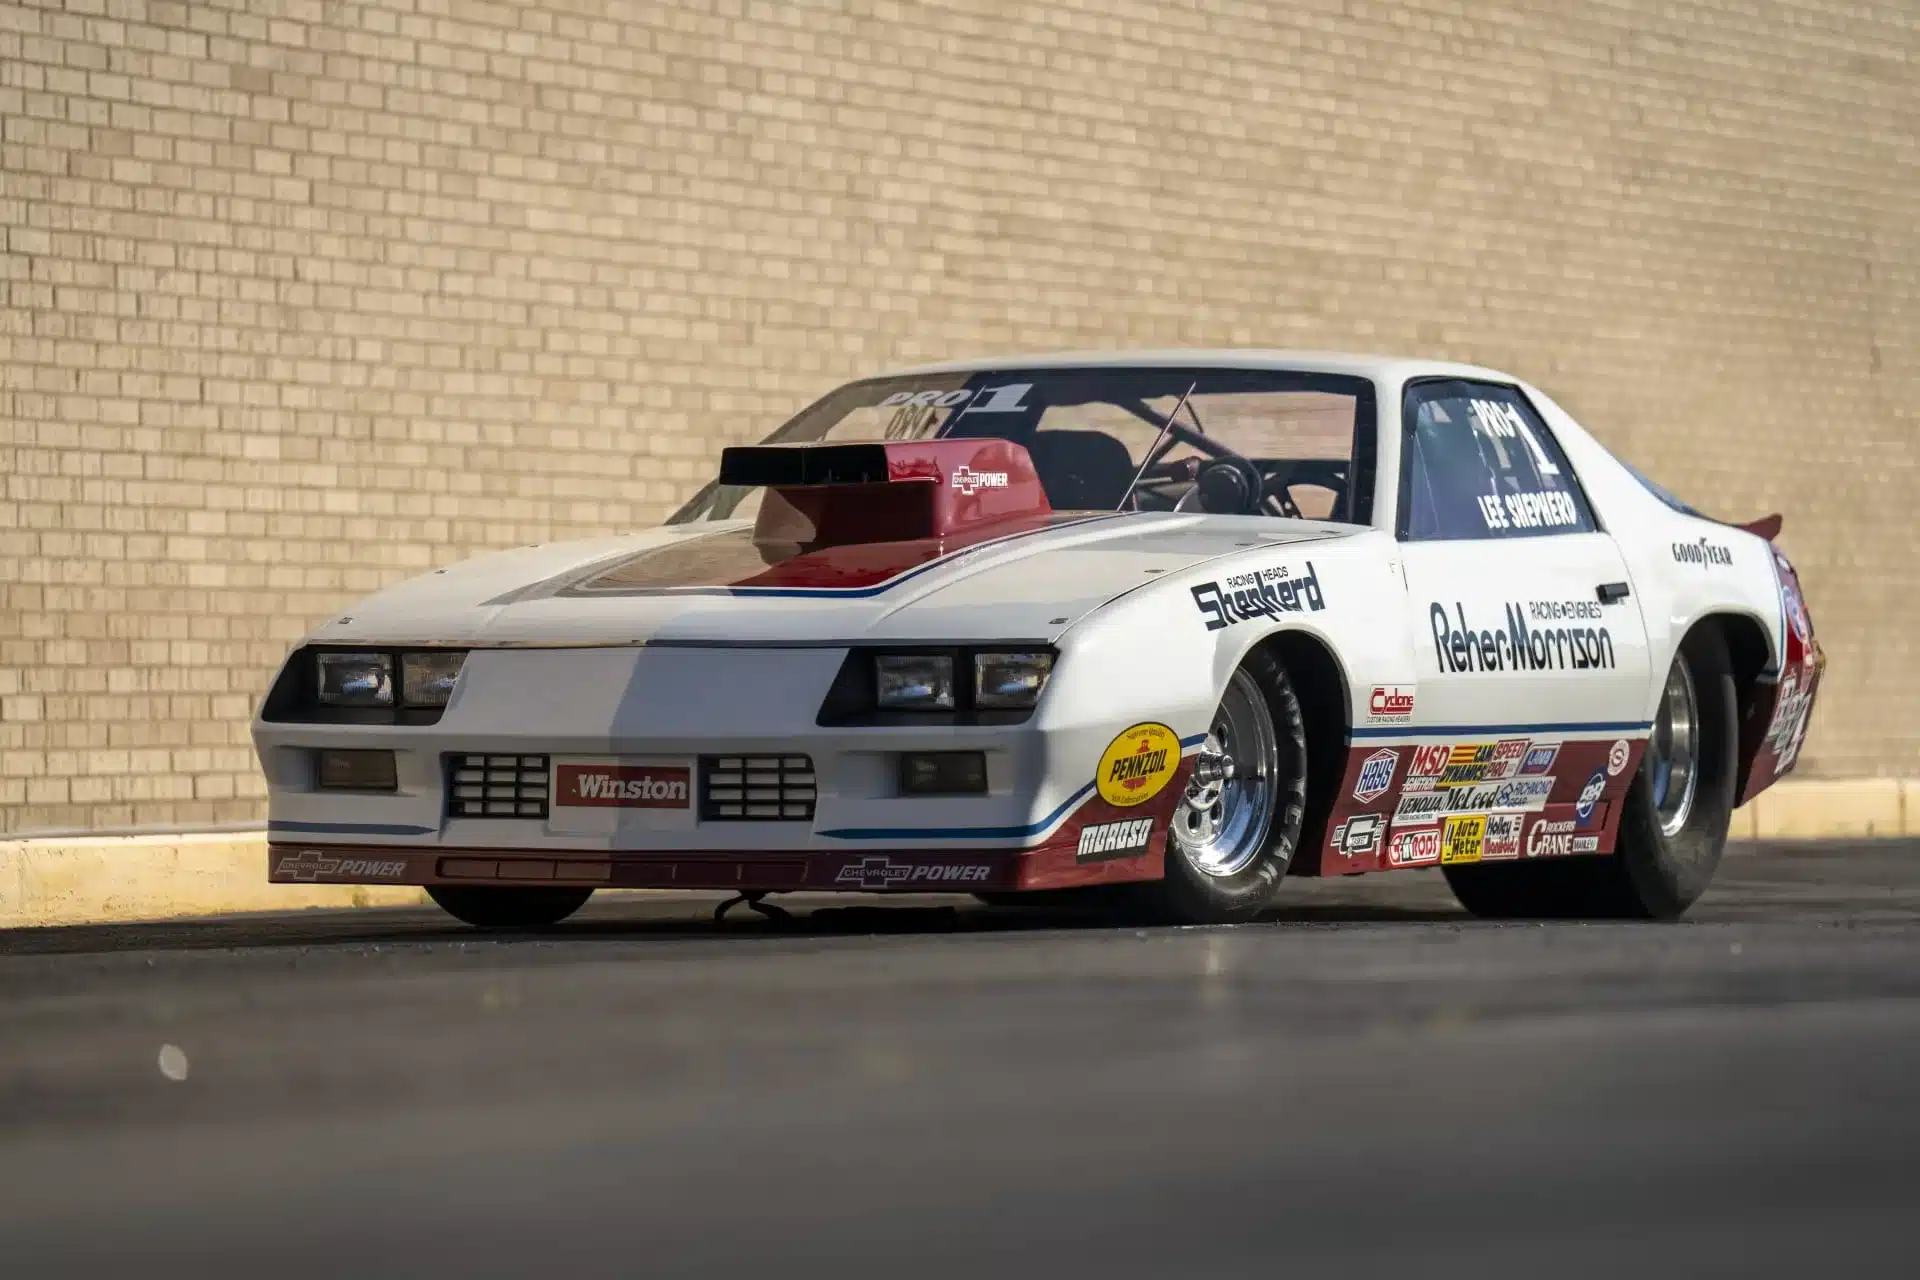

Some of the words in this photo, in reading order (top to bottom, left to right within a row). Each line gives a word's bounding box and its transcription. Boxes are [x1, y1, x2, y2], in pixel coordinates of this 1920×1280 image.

[876, 389, 973, 408] PRO
[965, 383, 1033, 412] 1
[1470, 397, 1516, 438] PRO
[1507, 402, 1559, 475] 1
[980, 472, 1008, 487] POWER
[1477, 496, 1511, 529] LEE
[1510, 491, 1577, 528] SHEPHERD
[1226, 573, 1255, 588] RACING
[1262, 566, 1289, 581] HEADS
[1190, 561, 1326, 632] Shepherd
[1370, 687, 1413, 715] Cyclone
[1409, 746, 1450, 775] MSD
[1493, 742, 1526, 760] SPEED
[1109, 748, 1168, 783] PENNZOIL
[1484, 760, 1509, 777] PRO
[578, 773, 688, 800] Winston
[1402, 776, 1438, 792] IGNITION
[1398, 796, 1443, 814] VENOLIA
[1446, 785, 1500, 811] McLeod
[1078, 818, 1154, 856] MOROSO
[1455, 819, 1480, 837] Auto
[1486, 816, 1512, 840] Holley
[1526, 818, 1573, 858] CRANE
[1545, 820, 1576, 833] ROCKERS
[1412, 834, 1438, 857] RODS
[1452, 837, 1481, 856] Meter
[338, 860, 407, 877] POWER
[844, 868, 908, 877] CHEVROLET
[911, 865, 991, 881] POWER
